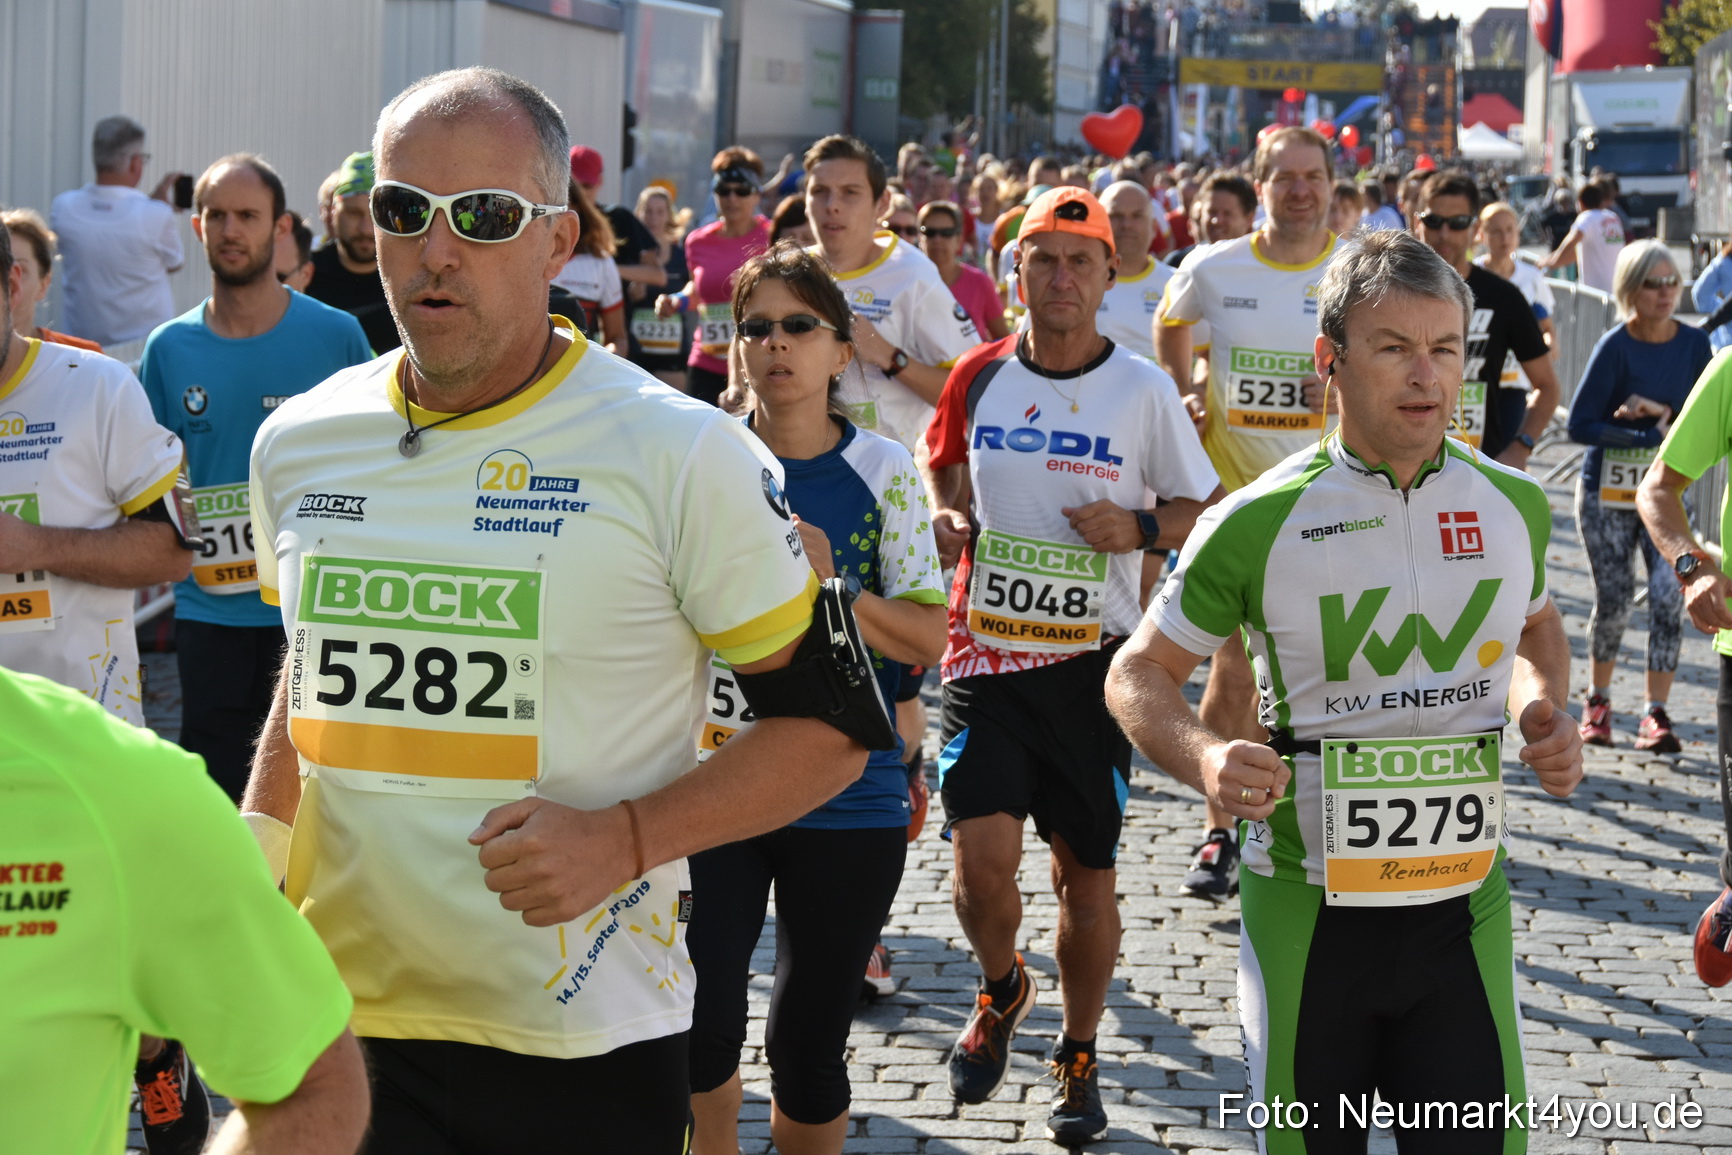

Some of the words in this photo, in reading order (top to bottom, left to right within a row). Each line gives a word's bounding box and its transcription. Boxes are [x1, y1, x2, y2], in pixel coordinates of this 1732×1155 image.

[1248, 66, 1315, 81] START
[1236, 351, 1316, 373] BOCK
[1243, 415, 1310, 428] MARKUS
[481, 461, 528, 491] 20
[533, 478, 575, 490] JAHRE
[298, 494, 368, 515] BOCK
[475, 495, 590, 513] Neumarkter
[473, 516, 565, 538] Stadtlauf
[1301, 516, 1385, 541] smartblock
[985, 535, 1096, 577] BOCK
[313, 565, 521, 630] BOCK
[984, 572, 1089, 618] 5048
[980, 617, 1087, 640] WOLFGANG
[316, 638, 508, 719] 5282
[519, 659, 531, 672] S
[1326, 695, 1371, 714] KW
[1381, 679, 1491, 709] ENERGIE
[1337, 742, 1489, 783] BOCK
[1347, 793, 1484, 848] 5279
[1488, 796, 1496, 805] S
[1380, 858, 1473, 880] Reinhard
[17, 921, 57, 936] 2019
[556, 964, 592, 1005] 14./15.
[620, 881, 650, 909] 2019
